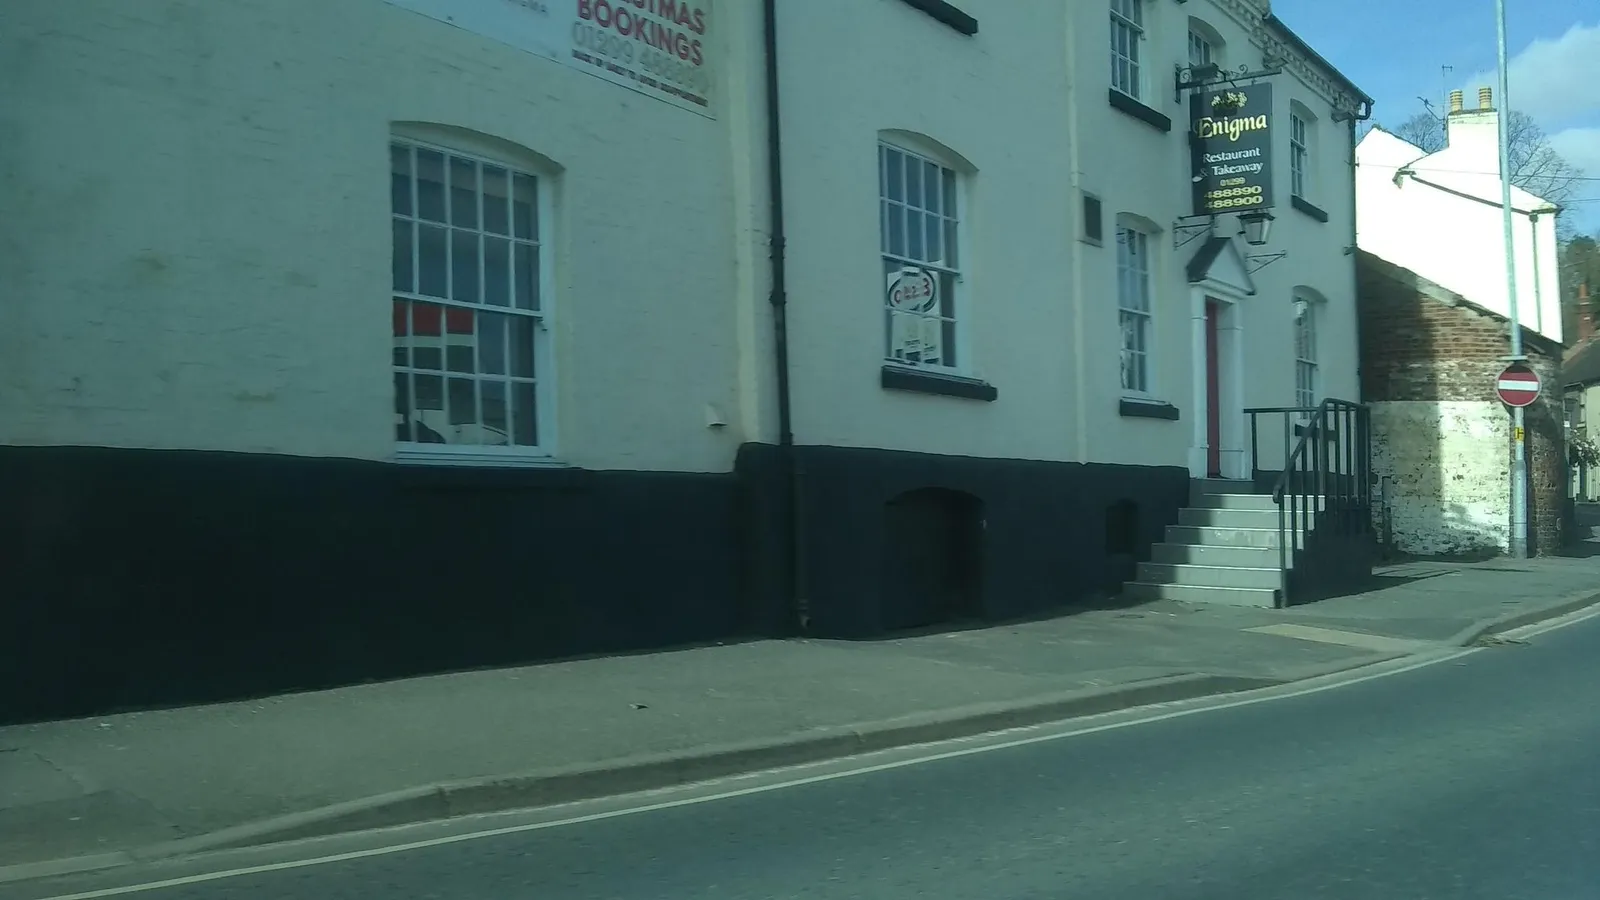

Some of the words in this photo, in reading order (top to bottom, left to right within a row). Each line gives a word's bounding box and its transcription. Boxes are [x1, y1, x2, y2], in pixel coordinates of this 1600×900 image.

[577, 0, 704, 66] BOOKINGS
[1194, 114, 1268, 141] Enigma
[1203, 147, 1261, 163] Restaurant
[1211, 162, 1264, 176] Takeaway
